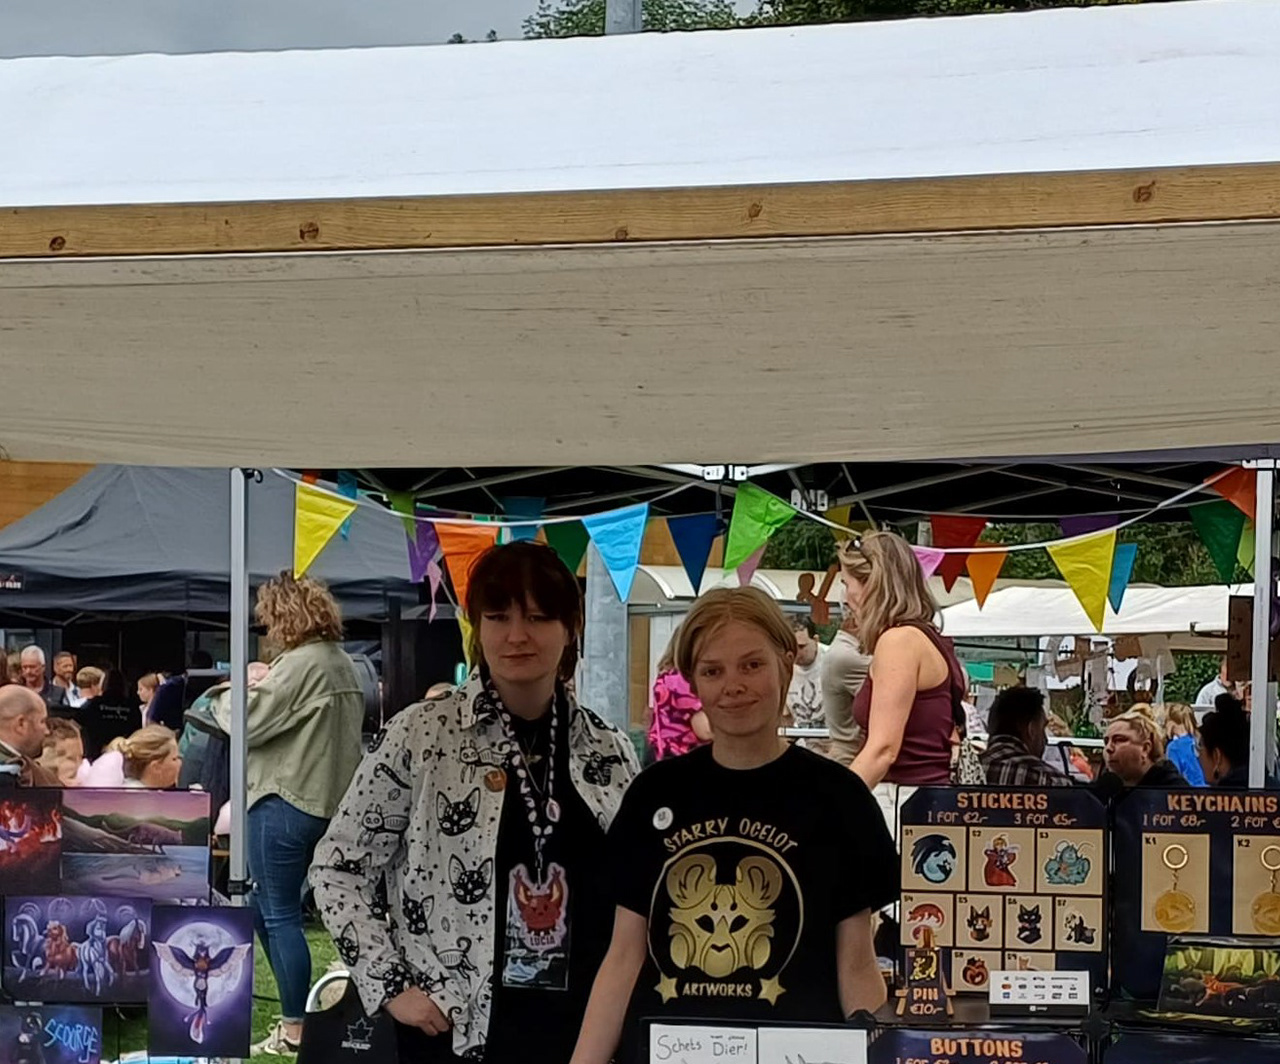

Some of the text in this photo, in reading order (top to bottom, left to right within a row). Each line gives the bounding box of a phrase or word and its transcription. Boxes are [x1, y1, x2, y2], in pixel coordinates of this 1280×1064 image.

[956, 791, 1049, 811] STICKERS
[1166, 793, 1278, 814] KEYCHAINS
[926, 810, 933, 823] 1
[1014, 813, 1022, 823] 3
[1142, 813, 1148, 826] 1
[1230, 815, 1240, 828] 2
[662, 816, 798, 854] STARRY OCELOT
[1144, 836, 1157, 846] K1
[1237, 838, 1251, 848] K2
[682, 982, 753, 997] ARTWORKS
[912, 987, 939, 1001] PIN
[43, 1018, 98, 1064] SCOURGE
[655, 1034, 748, 1060] Schets Dier!
[929, 1037, 1024, 1058] BUTTONS
